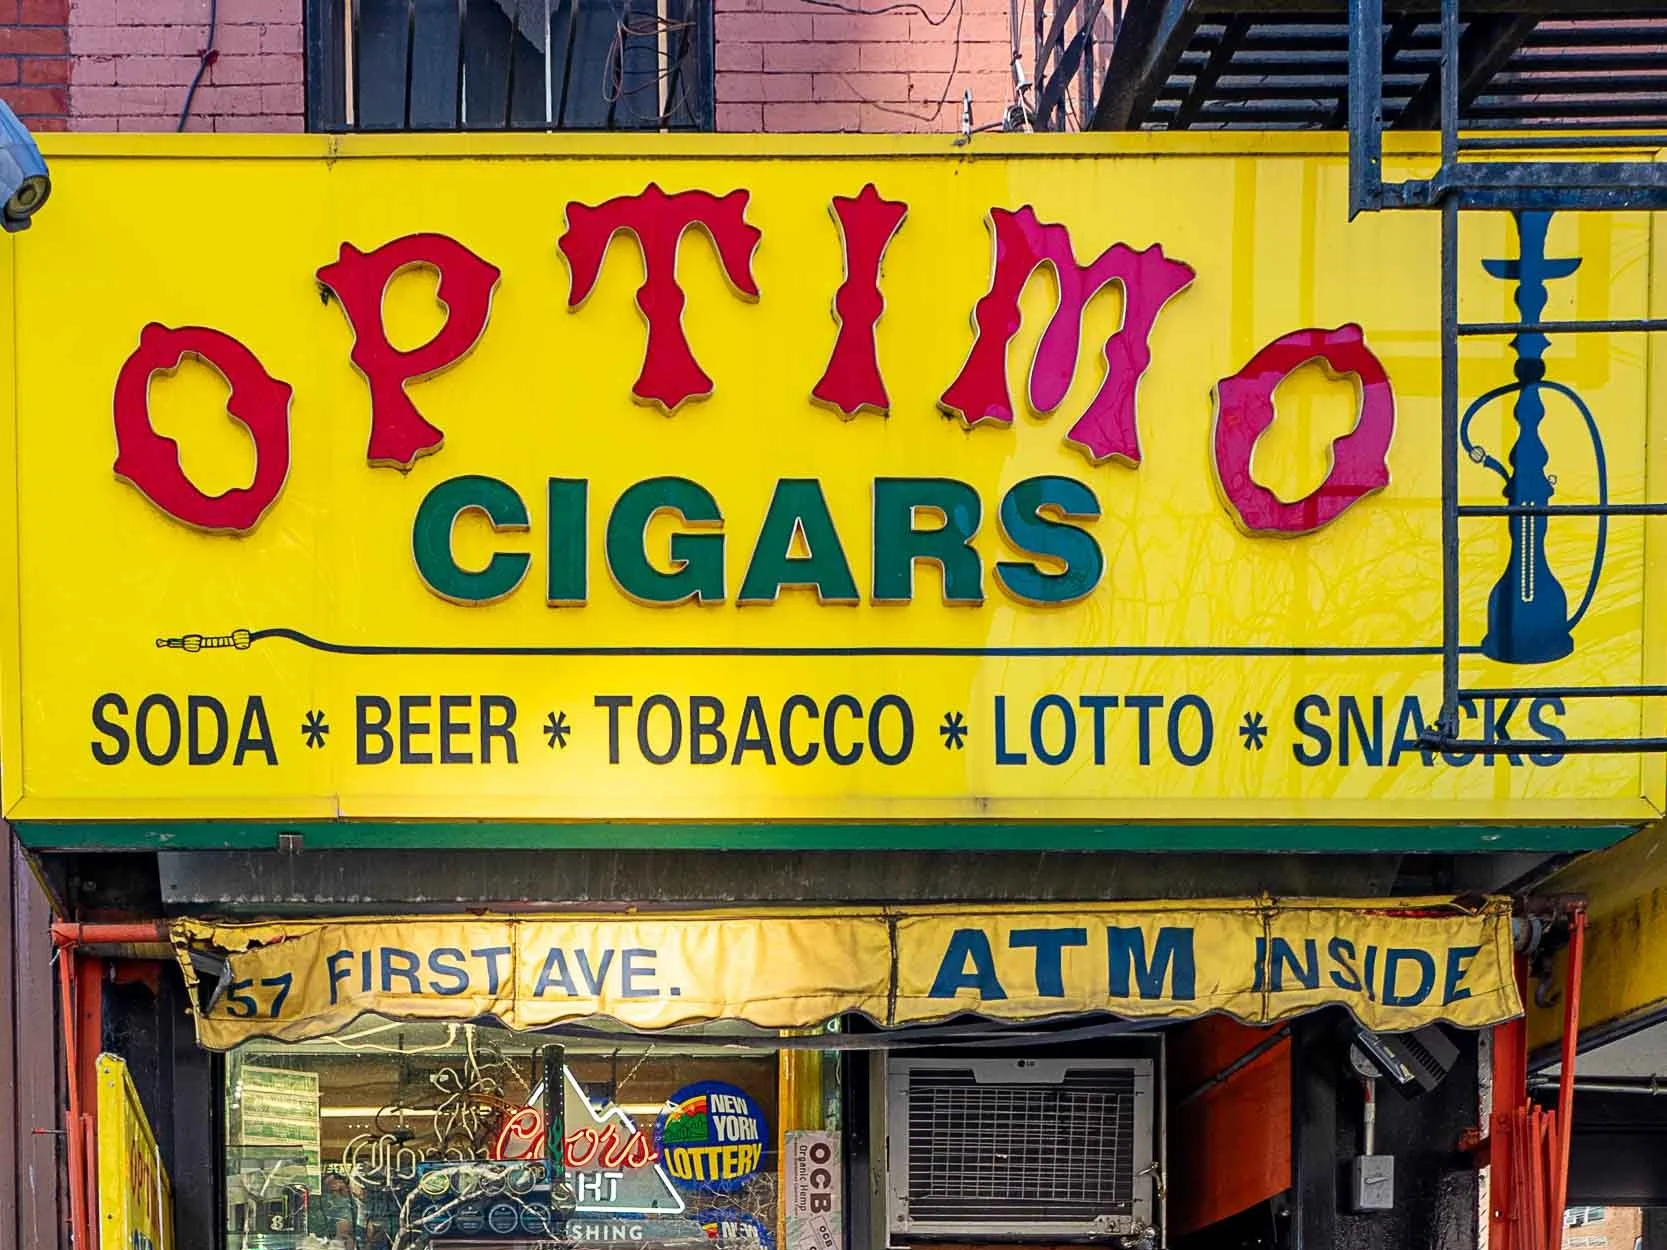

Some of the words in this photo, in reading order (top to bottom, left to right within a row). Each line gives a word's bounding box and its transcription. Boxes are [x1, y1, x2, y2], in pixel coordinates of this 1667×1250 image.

[113, 182, 1397, 538] OPTIMO
[412, 475, 1104, 608] CIGARS
[90, 692, 278, 766] SODA
[356, 695, 518, 765] BEER
[594, 693, 914, 767] TOBACCO
[994, 694, 1214, 767] LOTTO
[226, 975, 292, 1018] 57
[326, 945, 511, 1005] FIRST
[534, 947, 681, 998] AVE.
[928, 927, 1195, 1001] ATM
[1254, 935, 1483, 1007] INSIDE
[496, 1107, 658, 1168] Cors
[710, 1094, 748, 1115] NEW
[712, 1116, 759, 1142] YORK
[664, 1143, 762, 1181] LOTTERY
[799, 1145, 808, 1181] Organic
[810, 1142, 832, 1215] OCB
[819, 1225, 833, 1248] OCB
